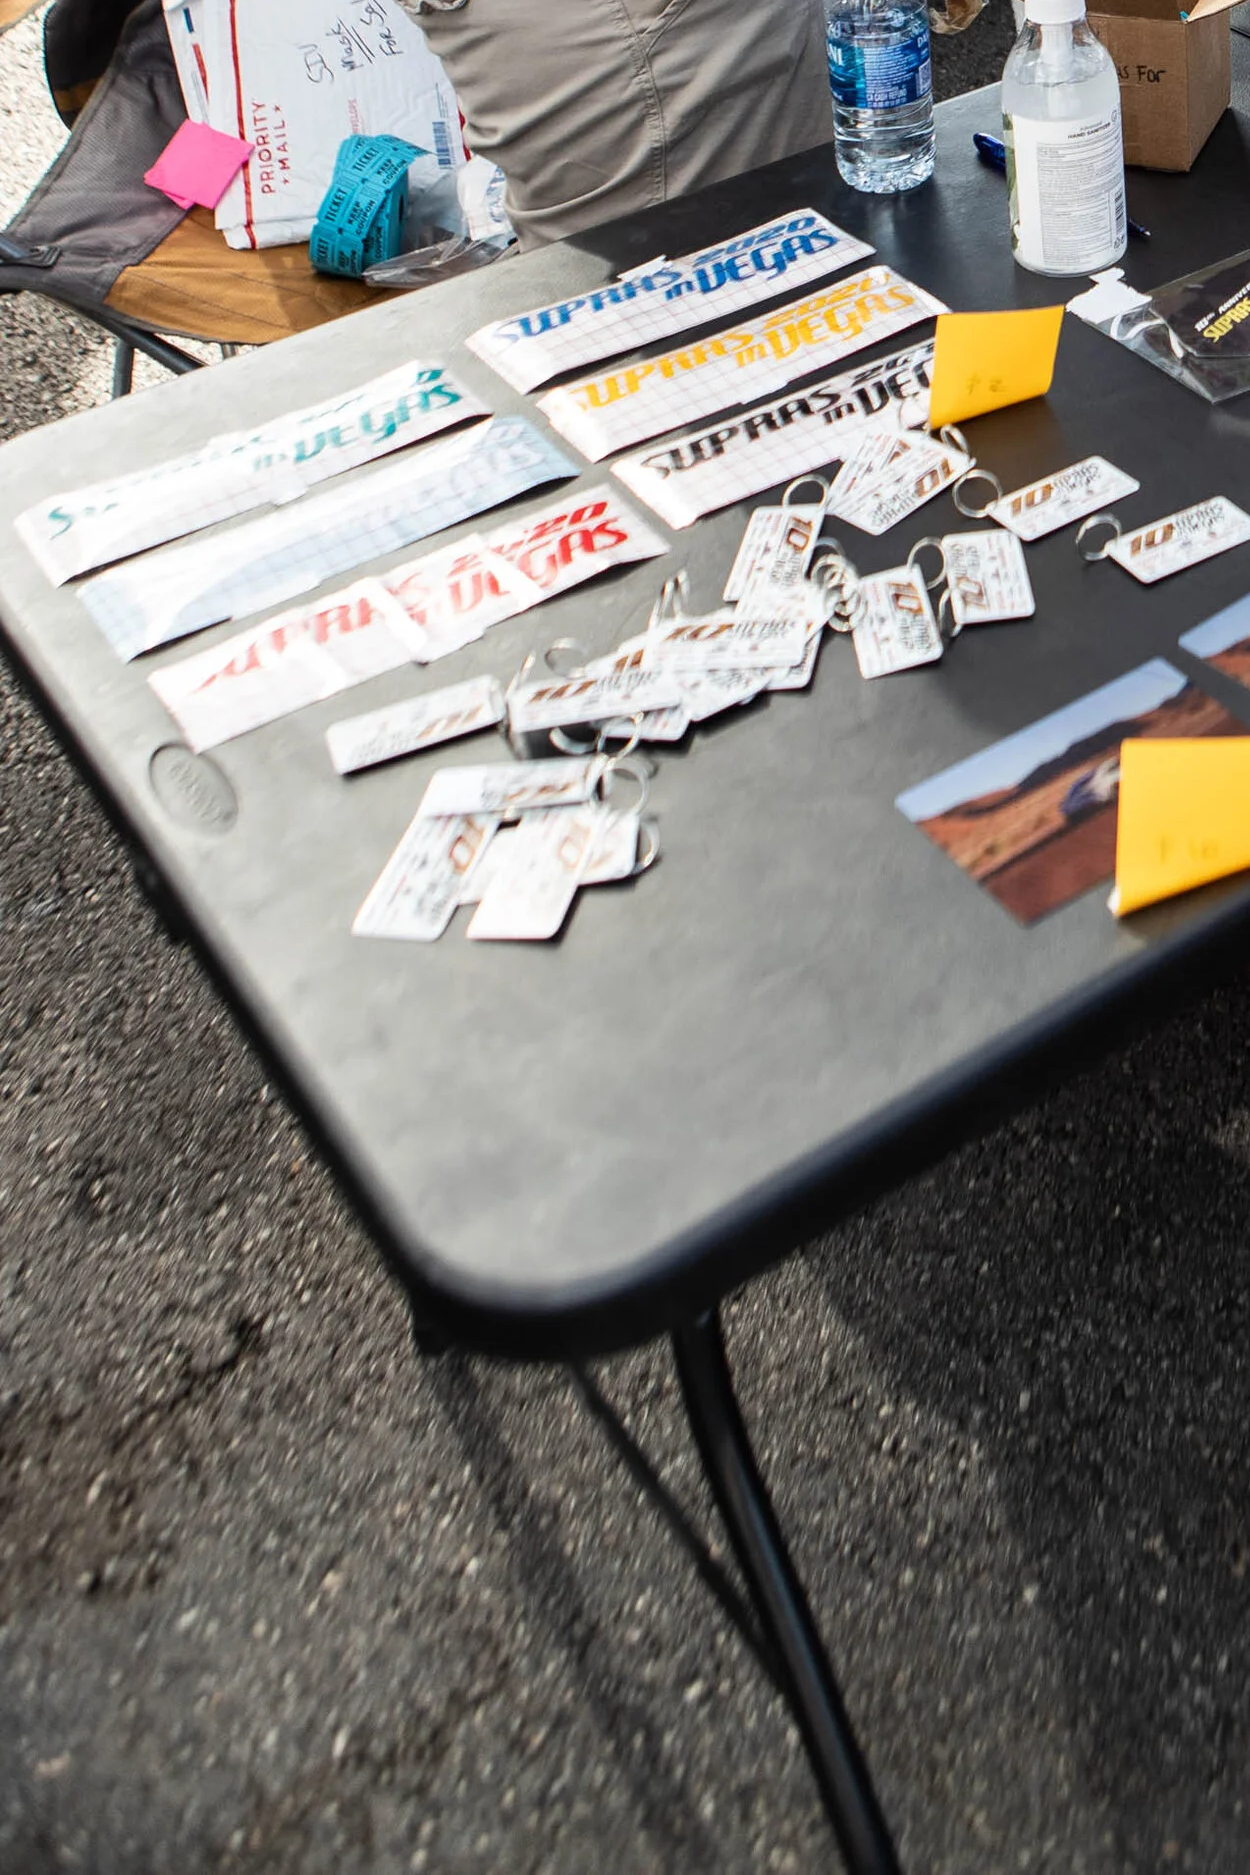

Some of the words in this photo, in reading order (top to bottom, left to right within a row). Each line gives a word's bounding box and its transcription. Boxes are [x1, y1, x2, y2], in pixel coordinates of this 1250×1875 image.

[1136, 64, 1167, 84] For
[251, 100, 277, 196] PRIORITY
[274, 113, 292, 176] MAIL
[353, 146, 379, 173] TICKET
[325, 187, 348, 223] TICKET
[356, 199, 377, 237] COUPON
[690, 227, 839, 294] VEGAS
[696, 215, 819, 263] 2020
[490, 265, 686, 347] SUPRAS
[761, 283, 918, 363] VEGAS
[641, 384, 844, 480] SUPRAS
